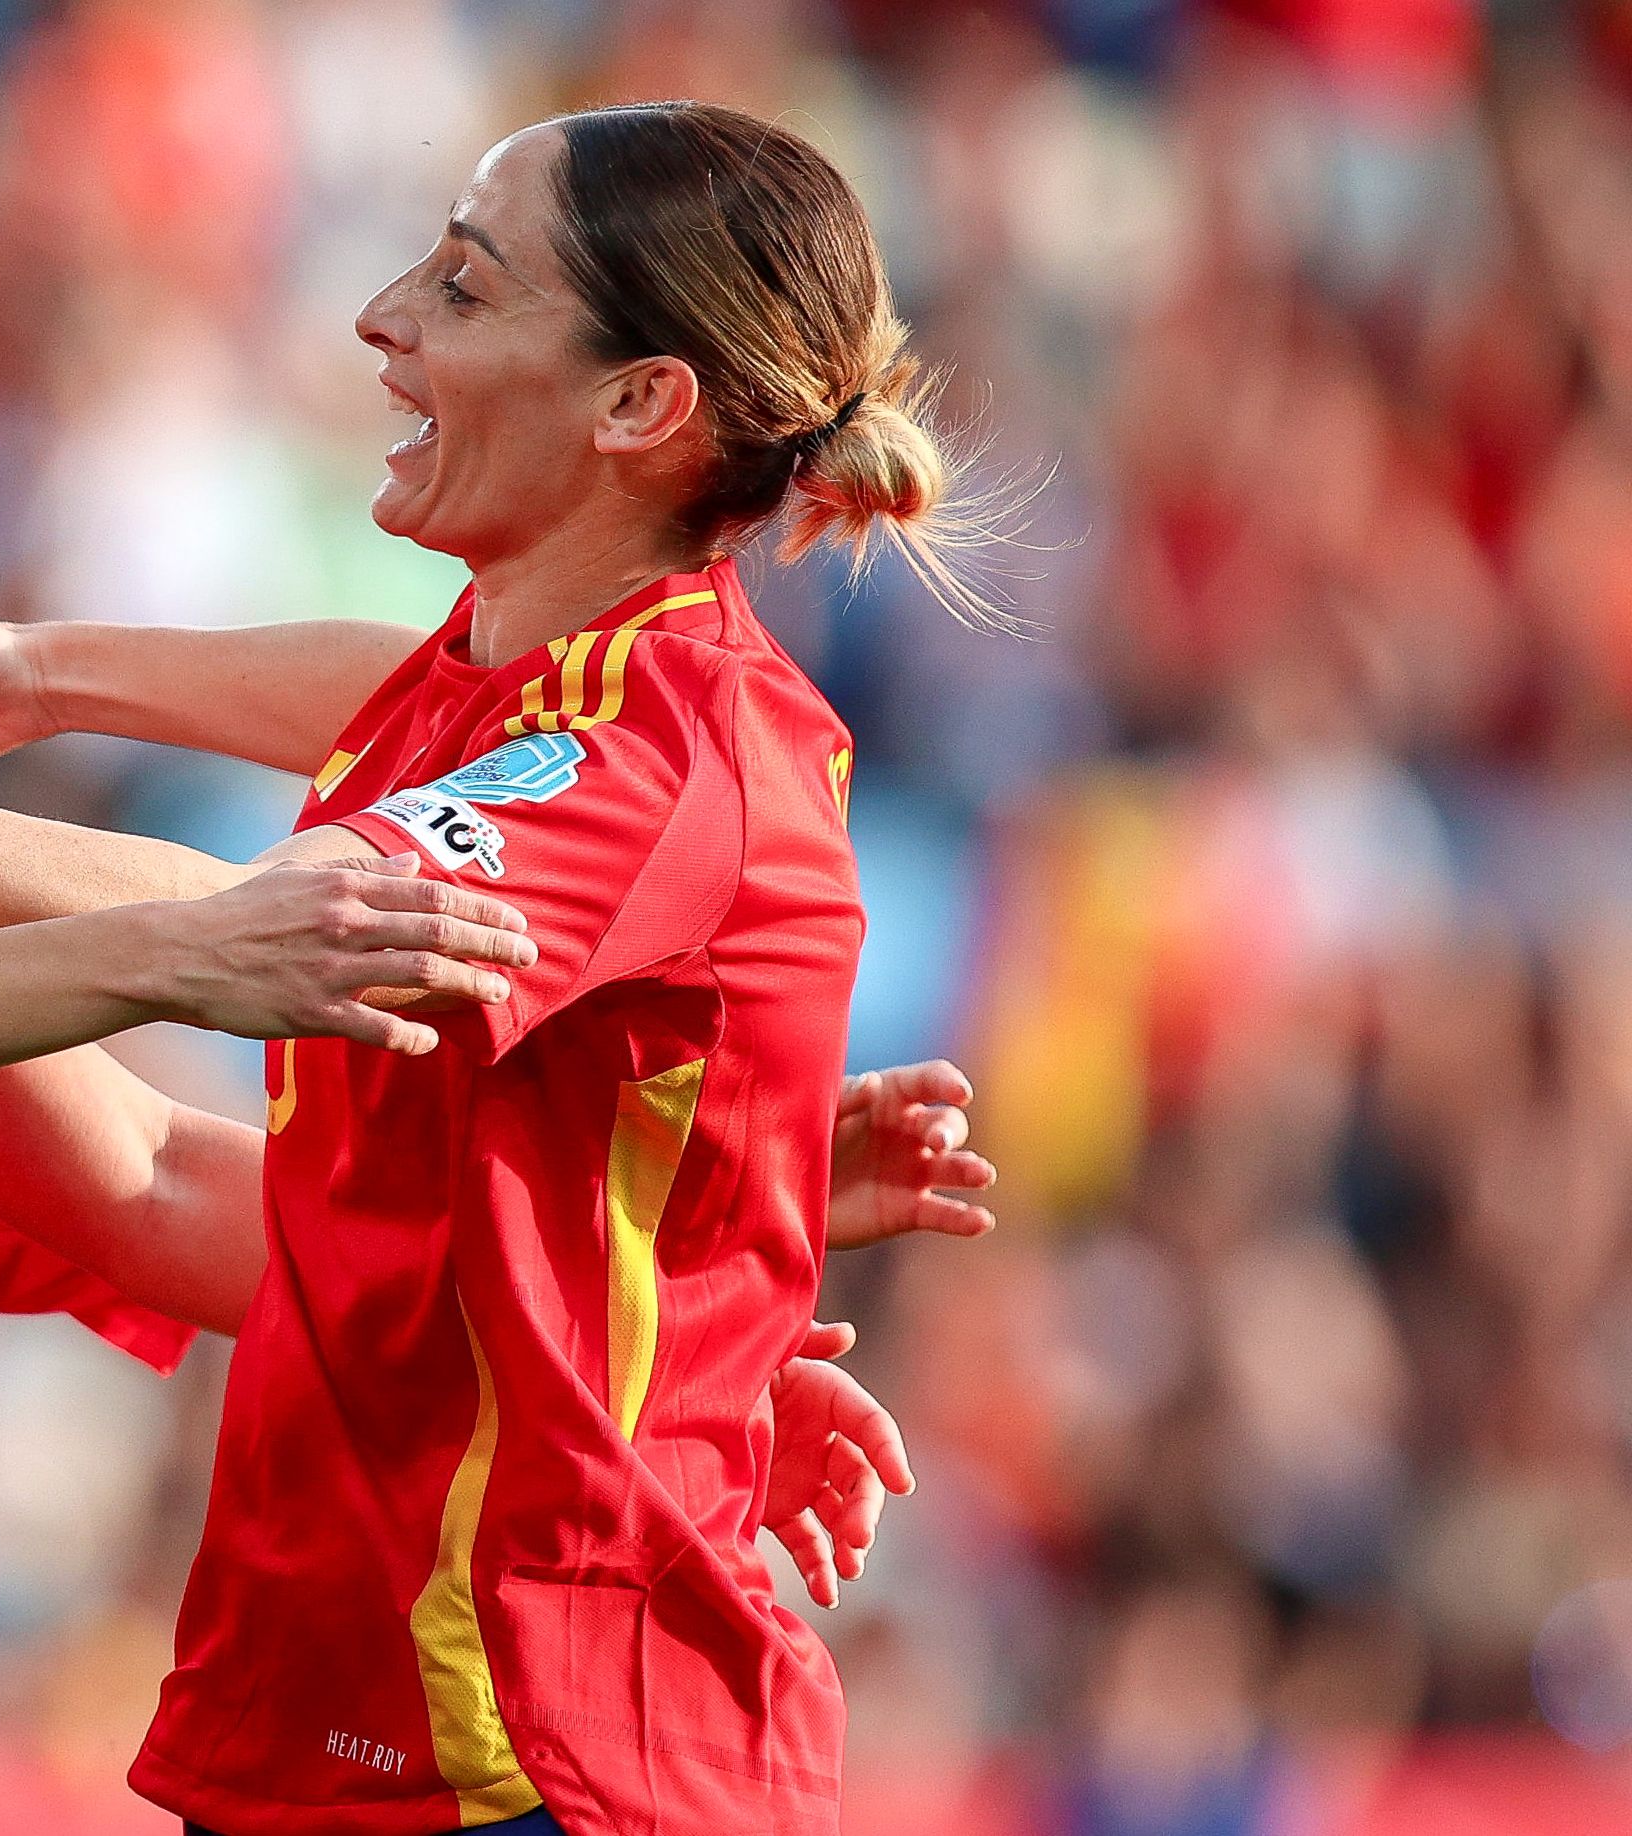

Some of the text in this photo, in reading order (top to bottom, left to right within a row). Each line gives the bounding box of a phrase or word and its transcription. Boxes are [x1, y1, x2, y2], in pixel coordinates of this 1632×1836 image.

[428, 806, 477, 853] 10
[478, 846, 499, 872] YEARS
[326, 1729, 406, 1776] HEAT.RDY
